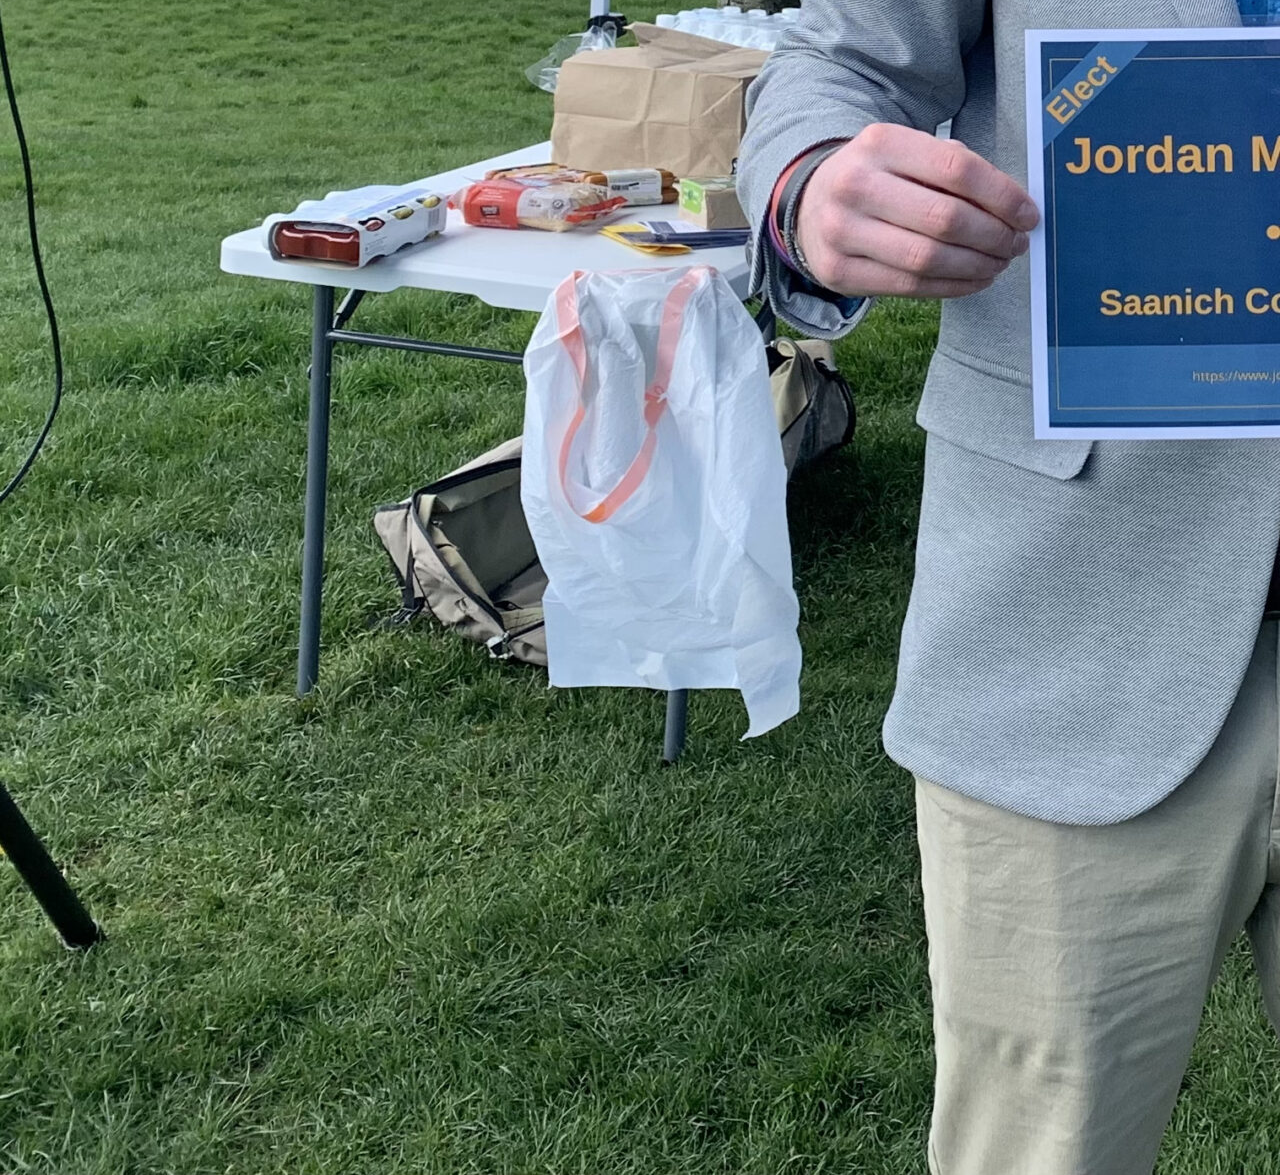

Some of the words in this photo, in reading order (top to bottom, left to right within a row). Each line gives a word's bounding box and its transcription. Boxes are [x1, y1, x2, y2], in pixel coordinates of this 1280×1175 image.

[1045, 54, 1118, 125] Elect
[1066, 135, 1234, 175] Jordan
[1100, 287, 1234, 317] Saanich
